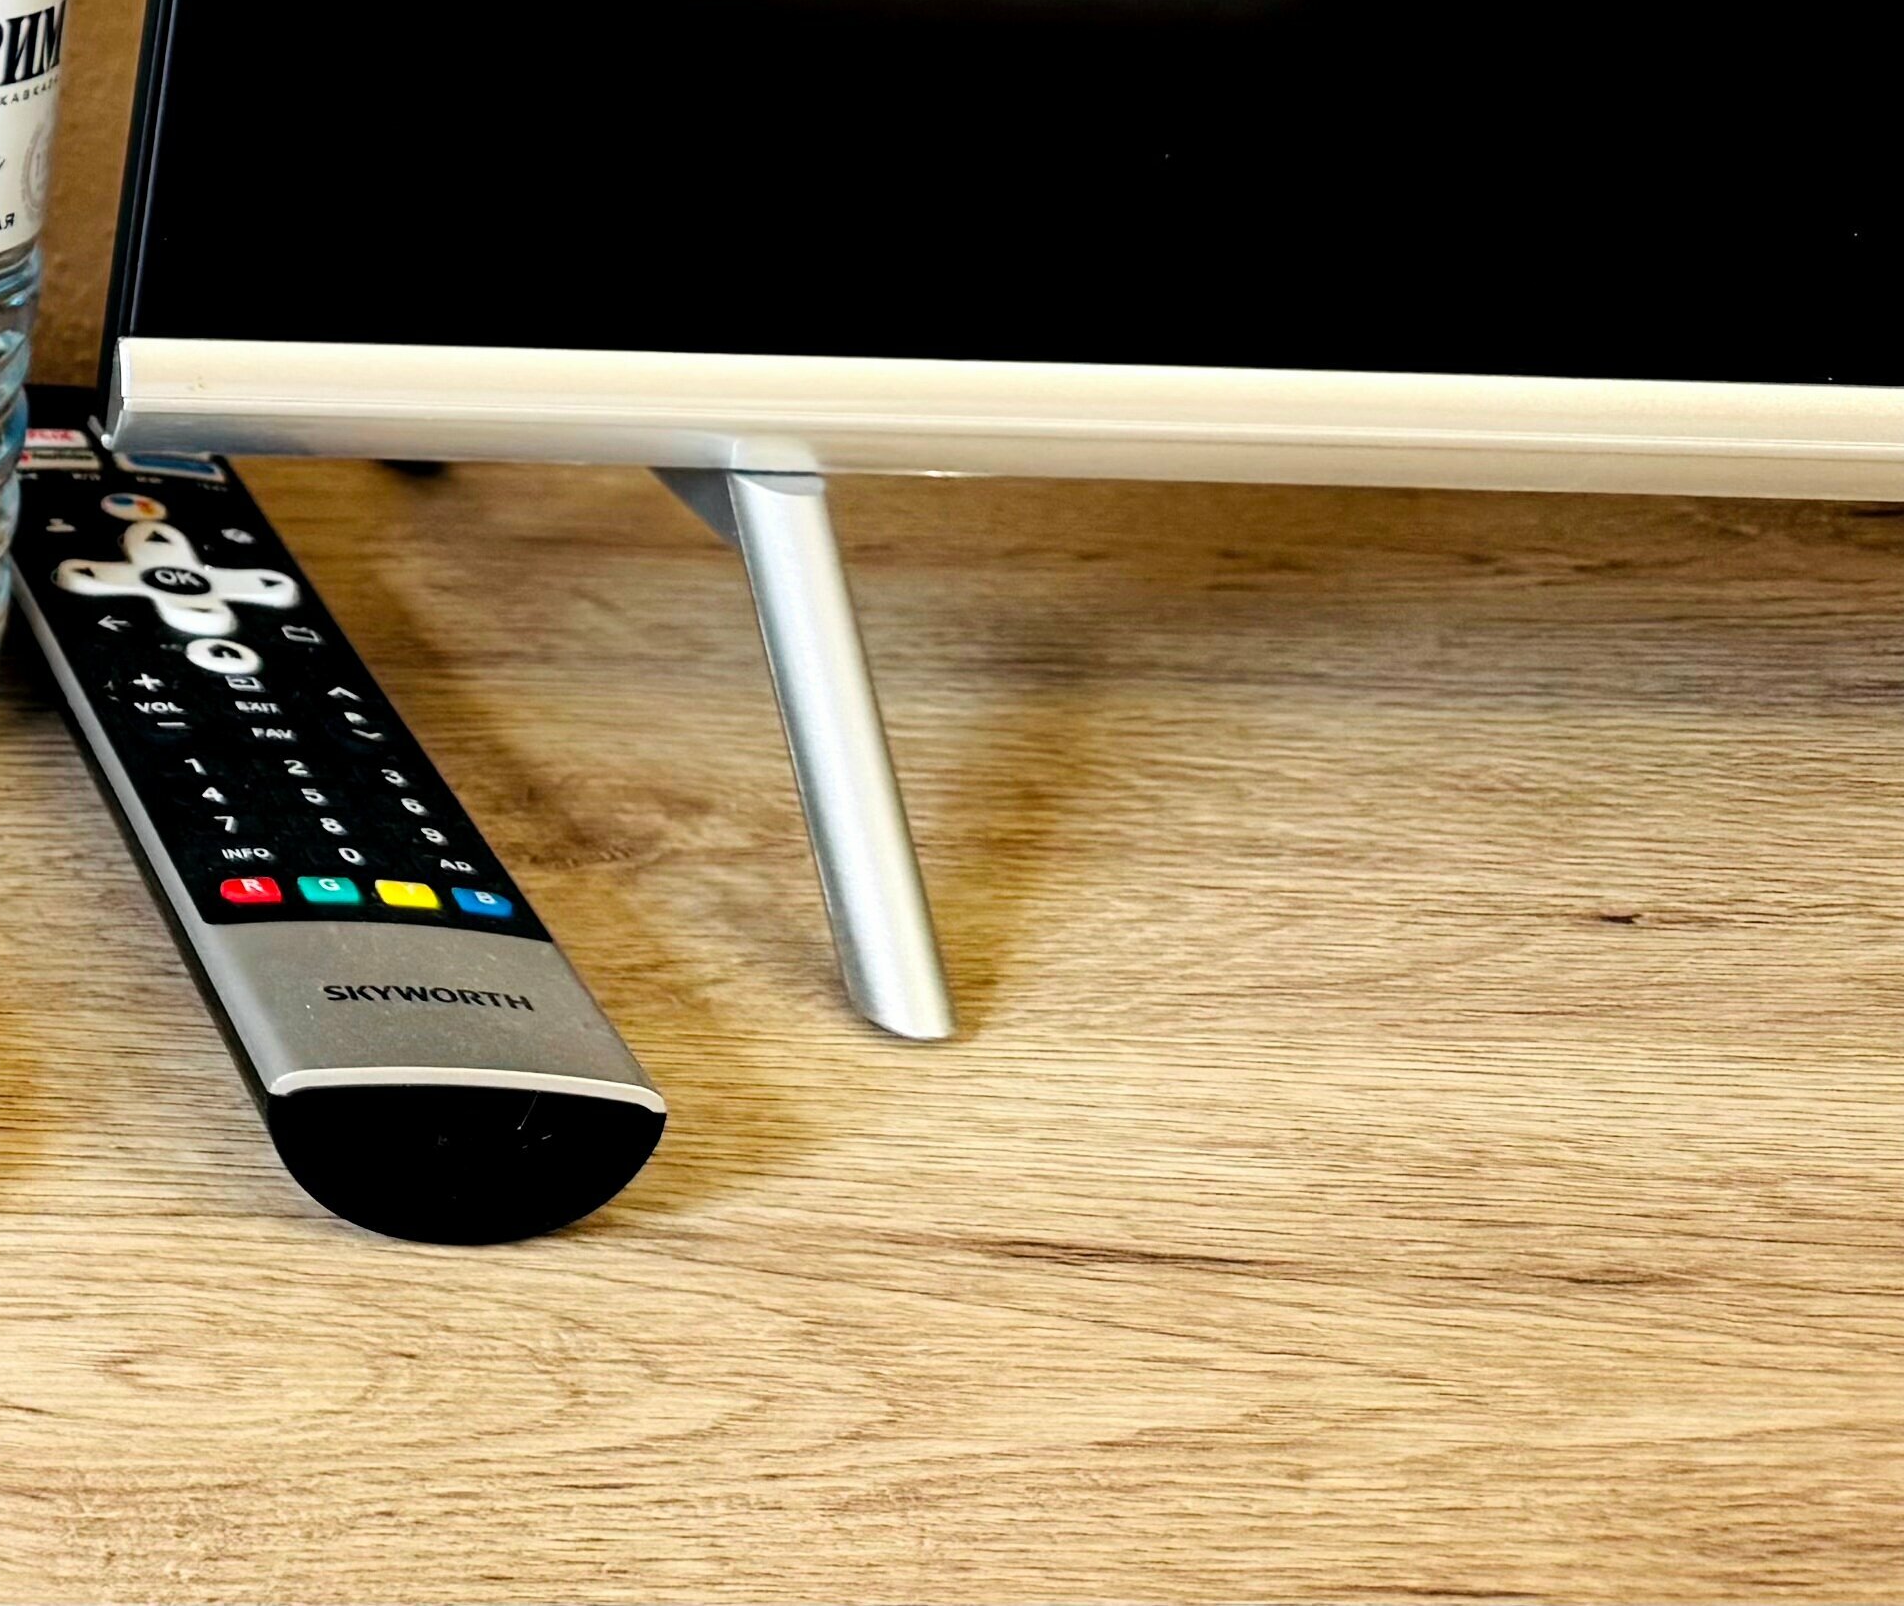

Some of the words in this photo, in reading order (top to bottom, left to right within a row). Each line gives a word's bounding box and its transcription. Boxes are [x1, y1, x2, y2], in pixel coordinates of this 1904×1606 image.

[154, 569, 203, 587] OK
[134, 701, 188, 714] VOL
[184, 757, 207, 776] 1
[283, 759, 312, 778] 2
[381, 768, 408, 788] 3
[201, 786, 227, 805] 4
[300, 788, 329, 806] 5
[400, 797, 429, 817] 6
[213, 815, 239, 834] 7
[319, 817, 348, 836] 8
[420, 826, 448, 845] 9
[221, 847, 274, 862] INFO
[439, 859, 478, 874] AD
[240, 878, 265, 893] R
[318, 878, 341, 892] G
[474, 890, 498, 905] B
[322, 984, 535, 1012] SKYWORTH
